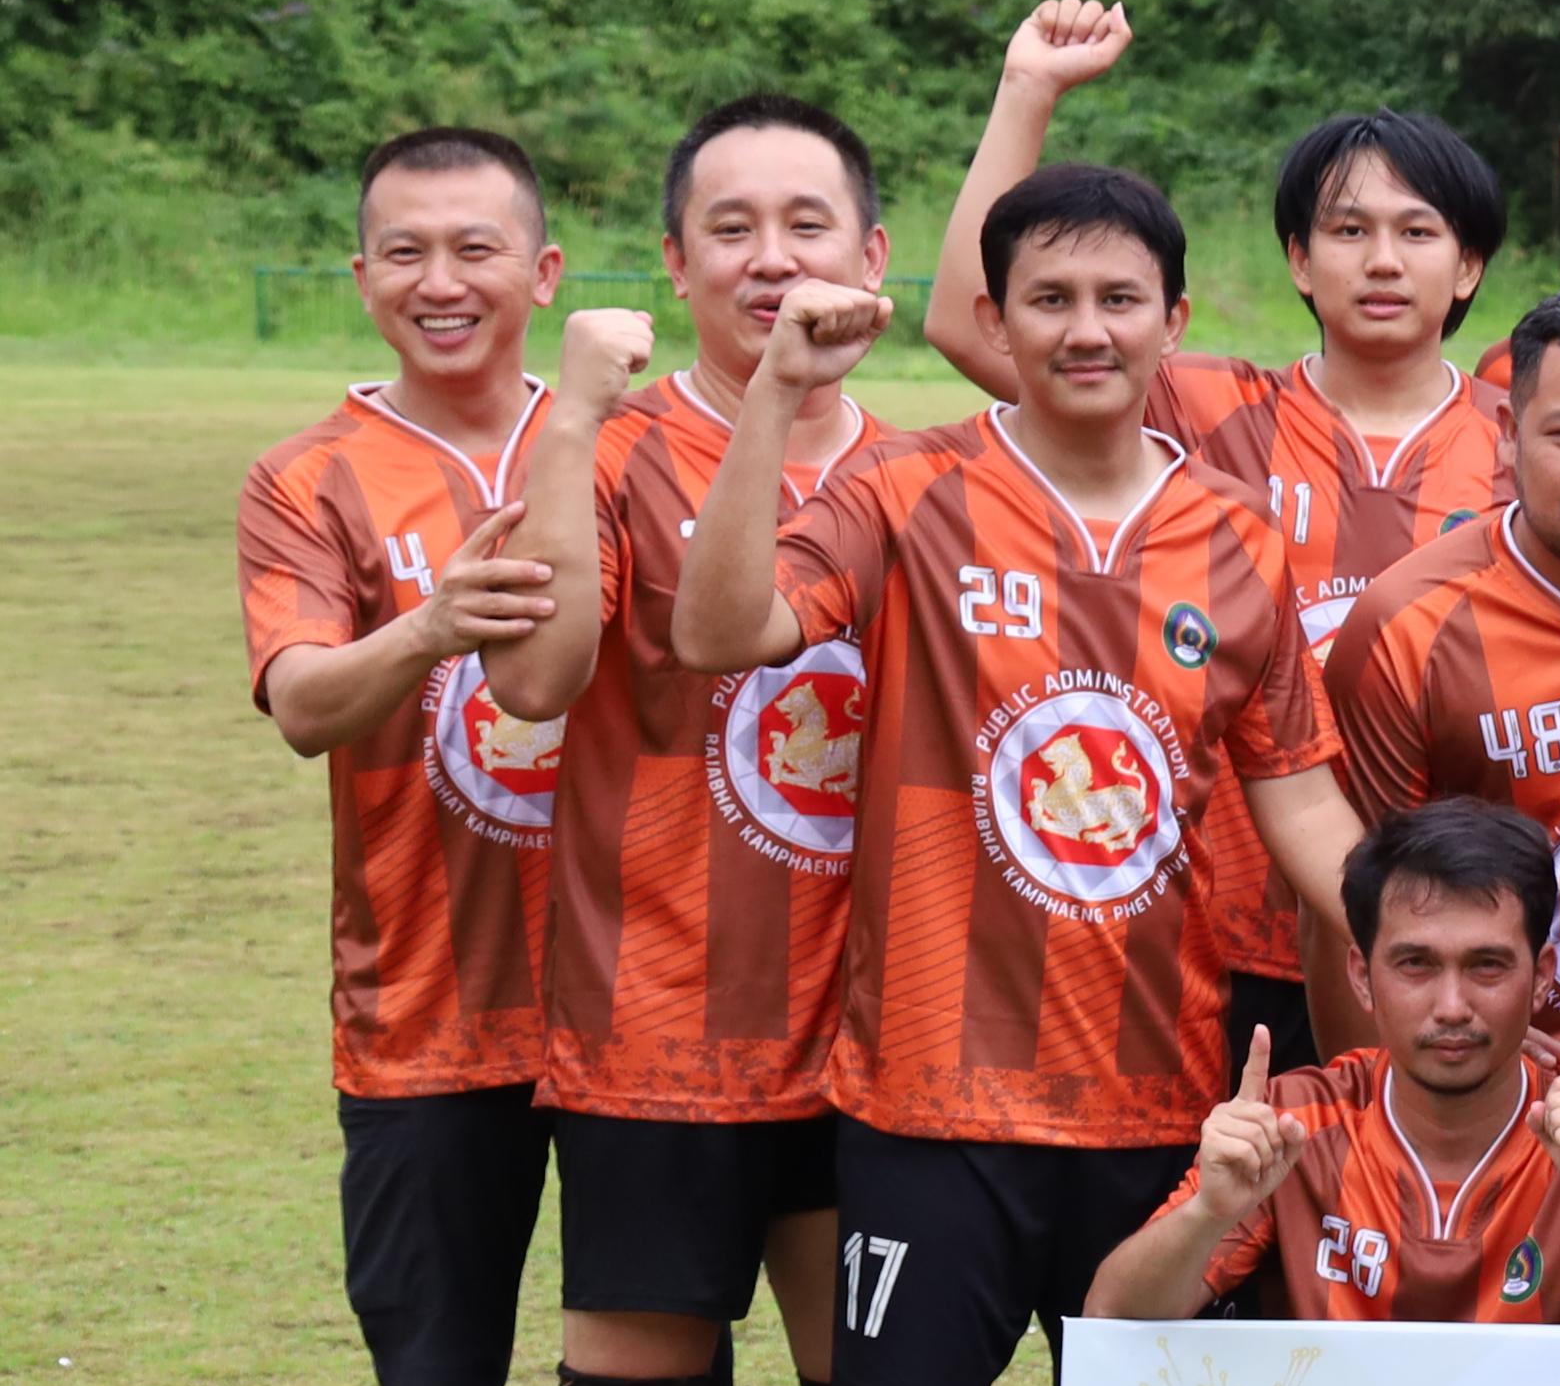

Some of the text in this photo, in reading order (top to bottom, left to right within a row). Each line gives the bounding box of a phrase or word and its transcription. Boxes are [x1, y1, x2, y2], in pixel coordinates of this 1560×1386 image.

[958, 565, 1043, 639] 29
[976, 670, 1189, 780] PUBLIC ADMINISTRATION
[740, 825, 849, 875] KAMPHAENG
[1003, 866, 1104, 924] KAMPHAENG
[1113, 892, 1152, 921] PHET
[843, 1231, 909, 1339] 17
[1316, 1214, 1389, 1298] 28
